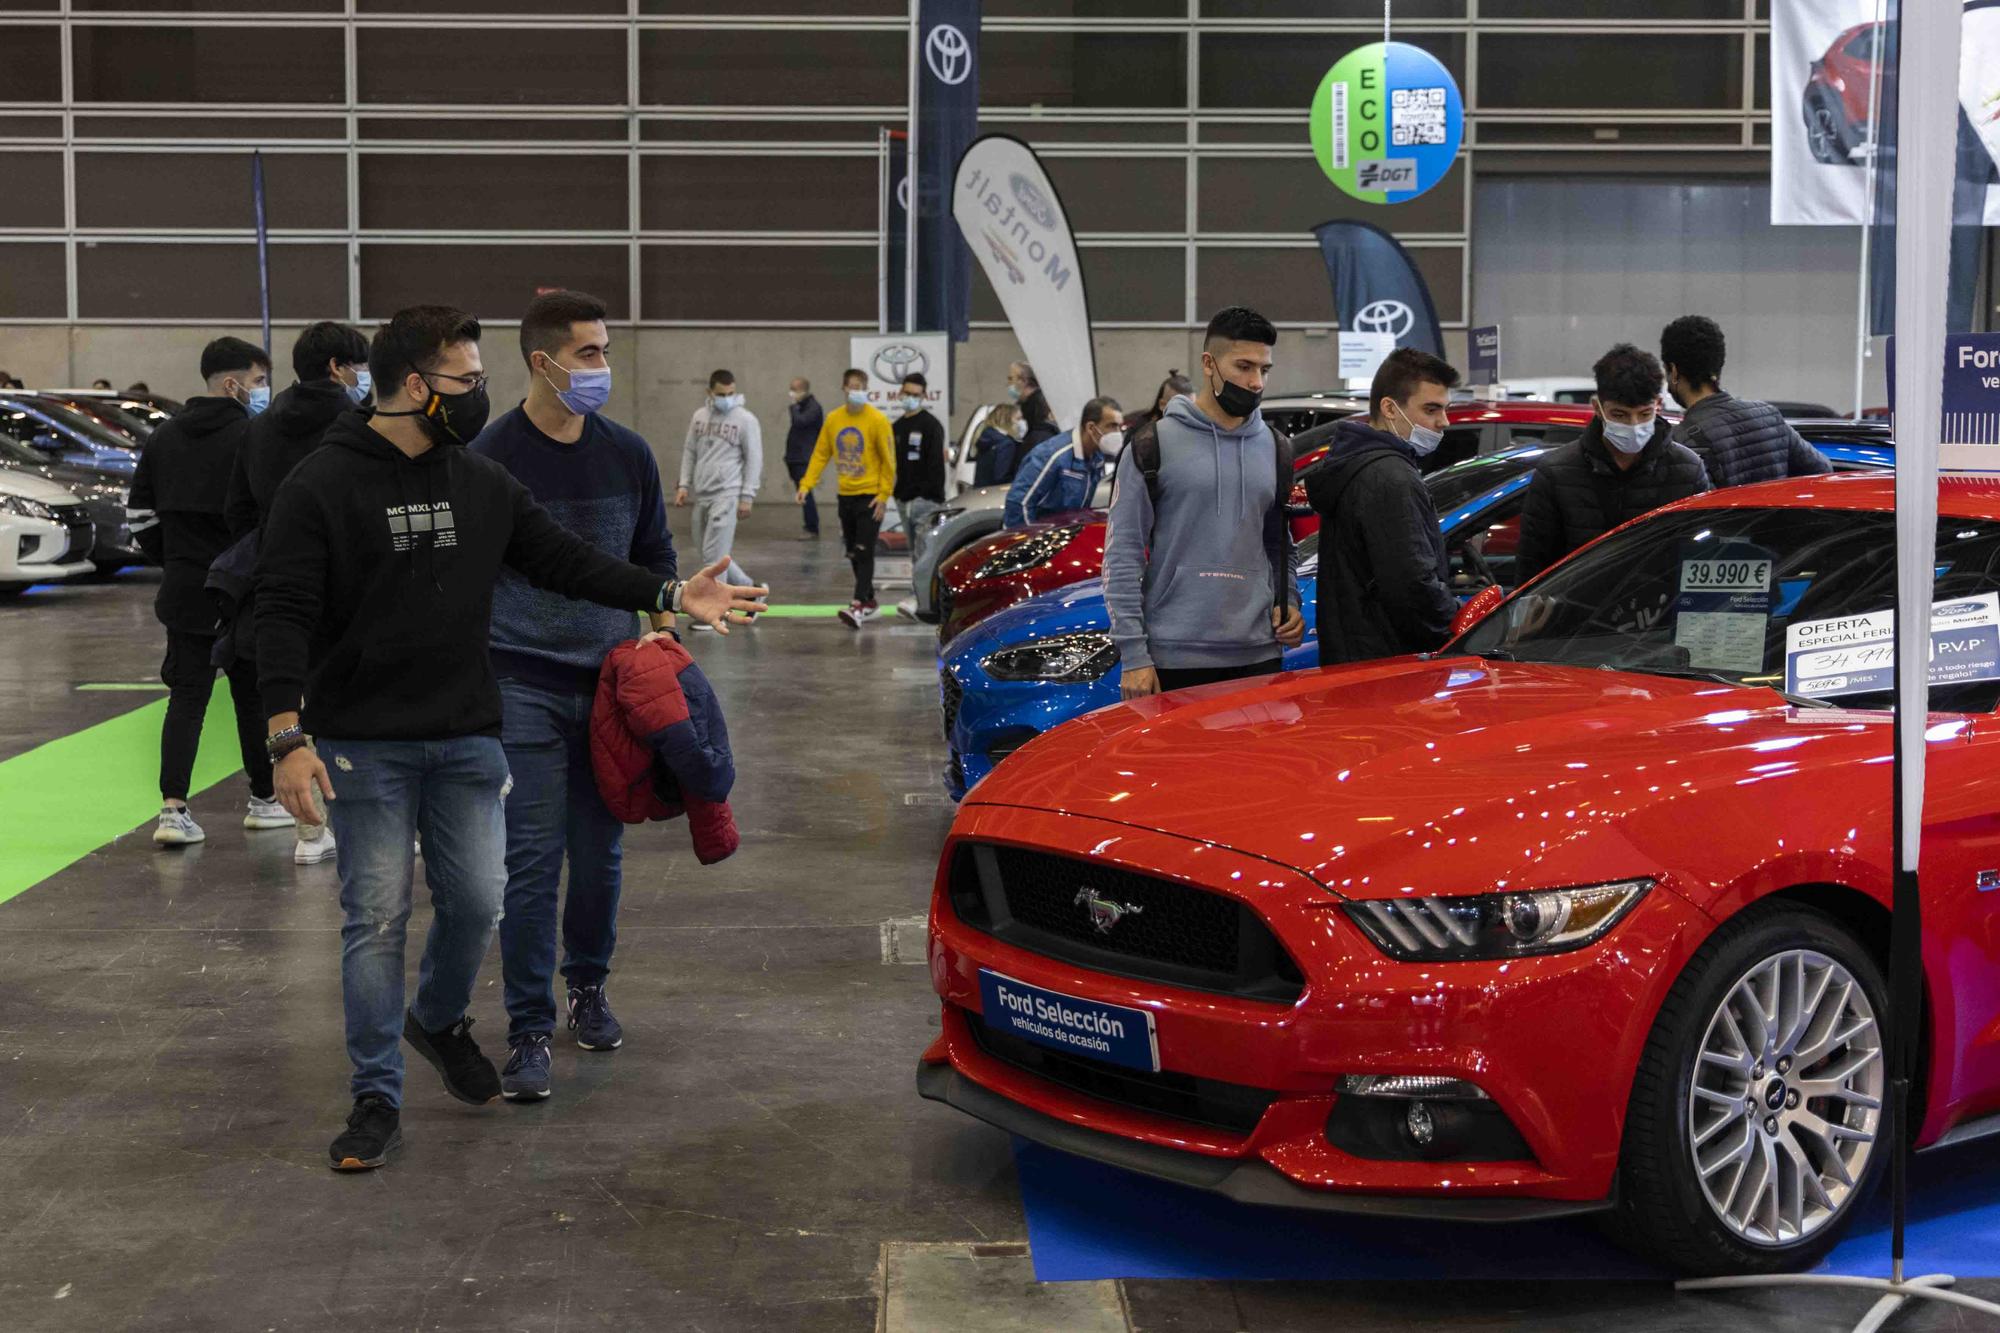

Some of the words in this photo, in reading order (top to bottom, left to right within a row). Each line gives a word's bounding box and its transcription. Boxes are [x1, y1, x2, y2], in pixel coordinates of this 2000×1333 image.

[1360, 68, 1380, 151] ECO
[1380, 167, 1413, 182] DGT
[1958, 346, 2000, 369] For
[1687, 562, 1749, 584] 39.990
[1754, 562, 1767, 584] €
[1936, 604, 1976, 616] Ford
[1952, 615, 1989, 624] Montalt
[1798, 617, 1872, 636] OFERTA
[1798, 633, 1859, 648] ESPECIAL
[1863, 628, 1894, 638] FERI
[1945, 663, 1966, 671] todo
[1968, 660, 1996, 669] riesgo
[997, 985, 1034, 1017] Ford
[1036, 998, 1125, 1039] Selección
[1011, 1015, 1054, 1039] vehículos
[1055, 1028, 1068, 1042] de
[1069, 1033, 1110, 1053] ocasión
